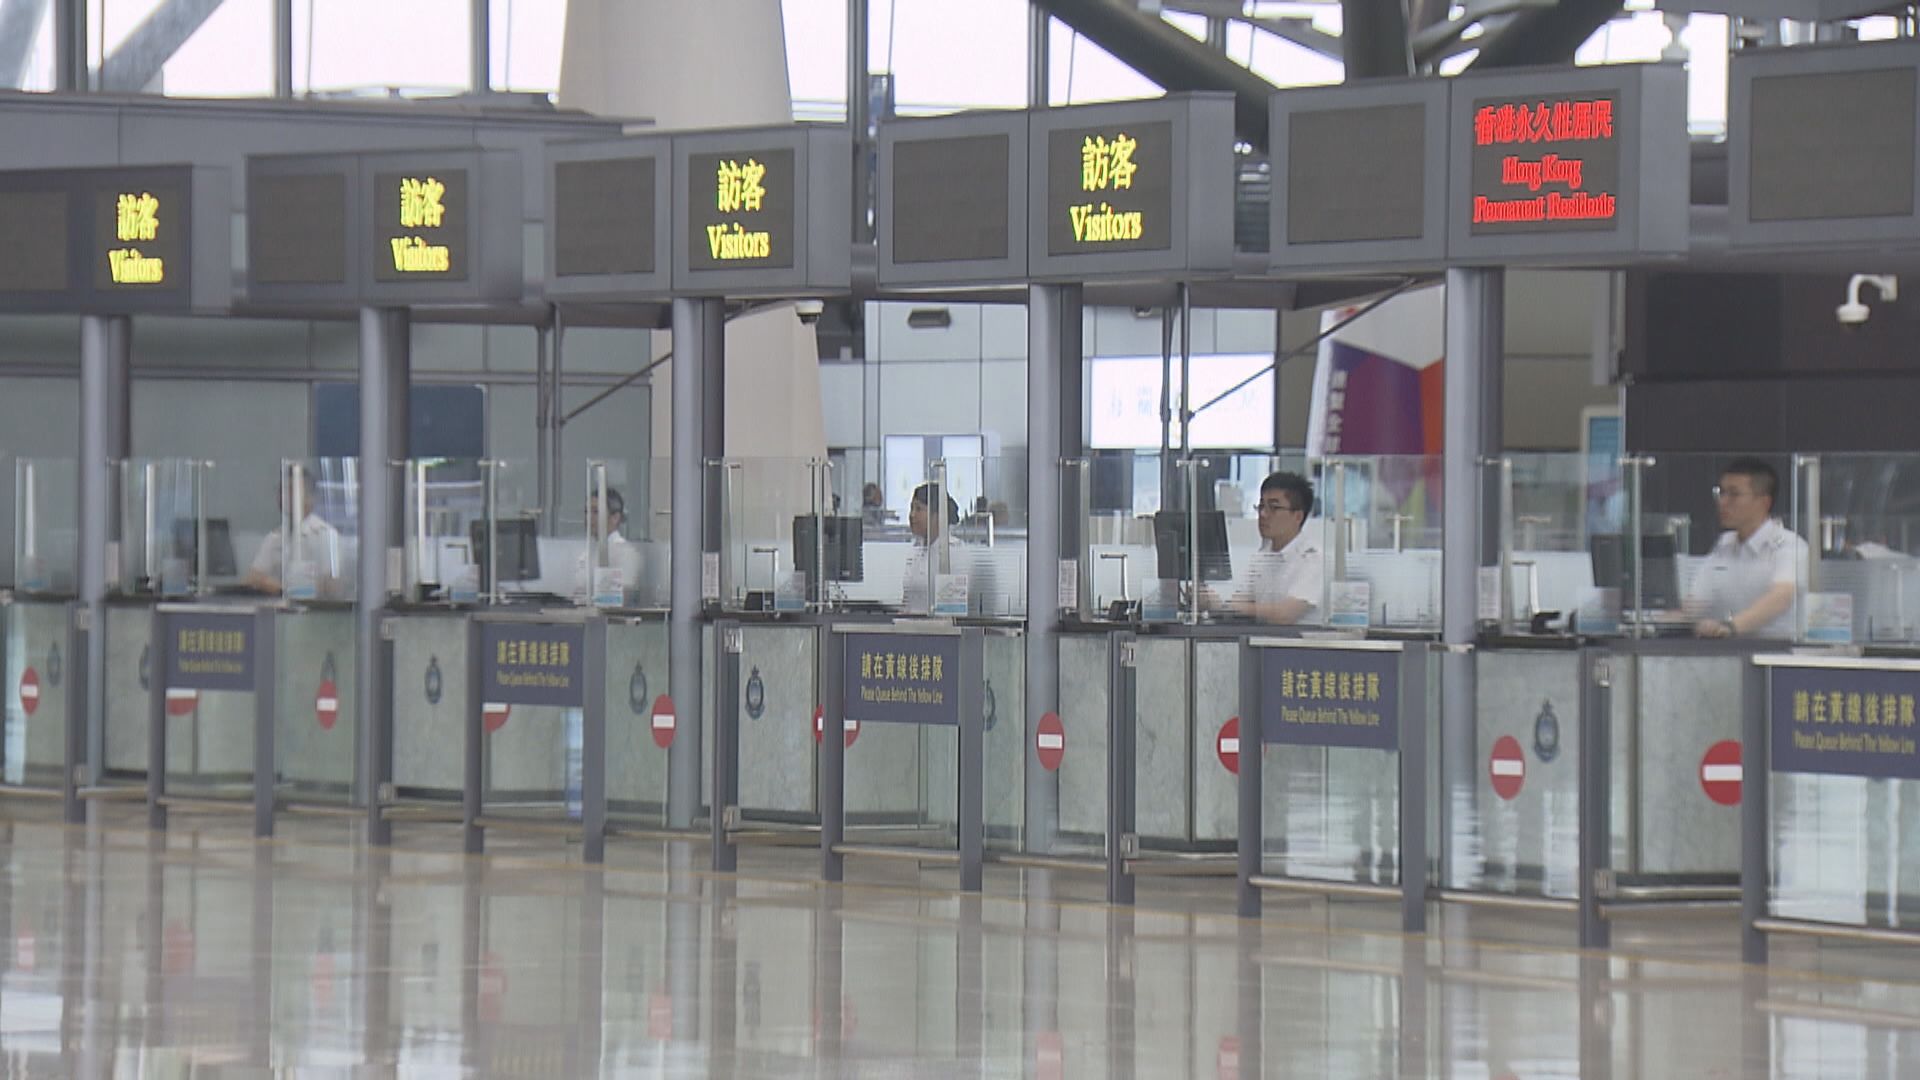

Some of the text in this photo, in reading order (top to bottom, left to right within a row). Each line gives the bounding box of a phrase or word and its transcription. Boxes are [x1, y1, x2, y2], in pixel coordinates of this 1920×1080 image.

[1475, 100, 1613, 145] 香港永久性居民
[718, 158, 765, 210] 訪客
[1082, 135, 1136, 189] 訪客
[1502, 154, 1583, 191] Hong Kong
[117, 193, 158, 240] 訪客
[400, 178, 444, 227] 訪客
[1071, 202, 1142, 240] Visitors
[707, 223, 770, 258] Visitors
[861, 653, 943, 681] 請在黃線後排隊
